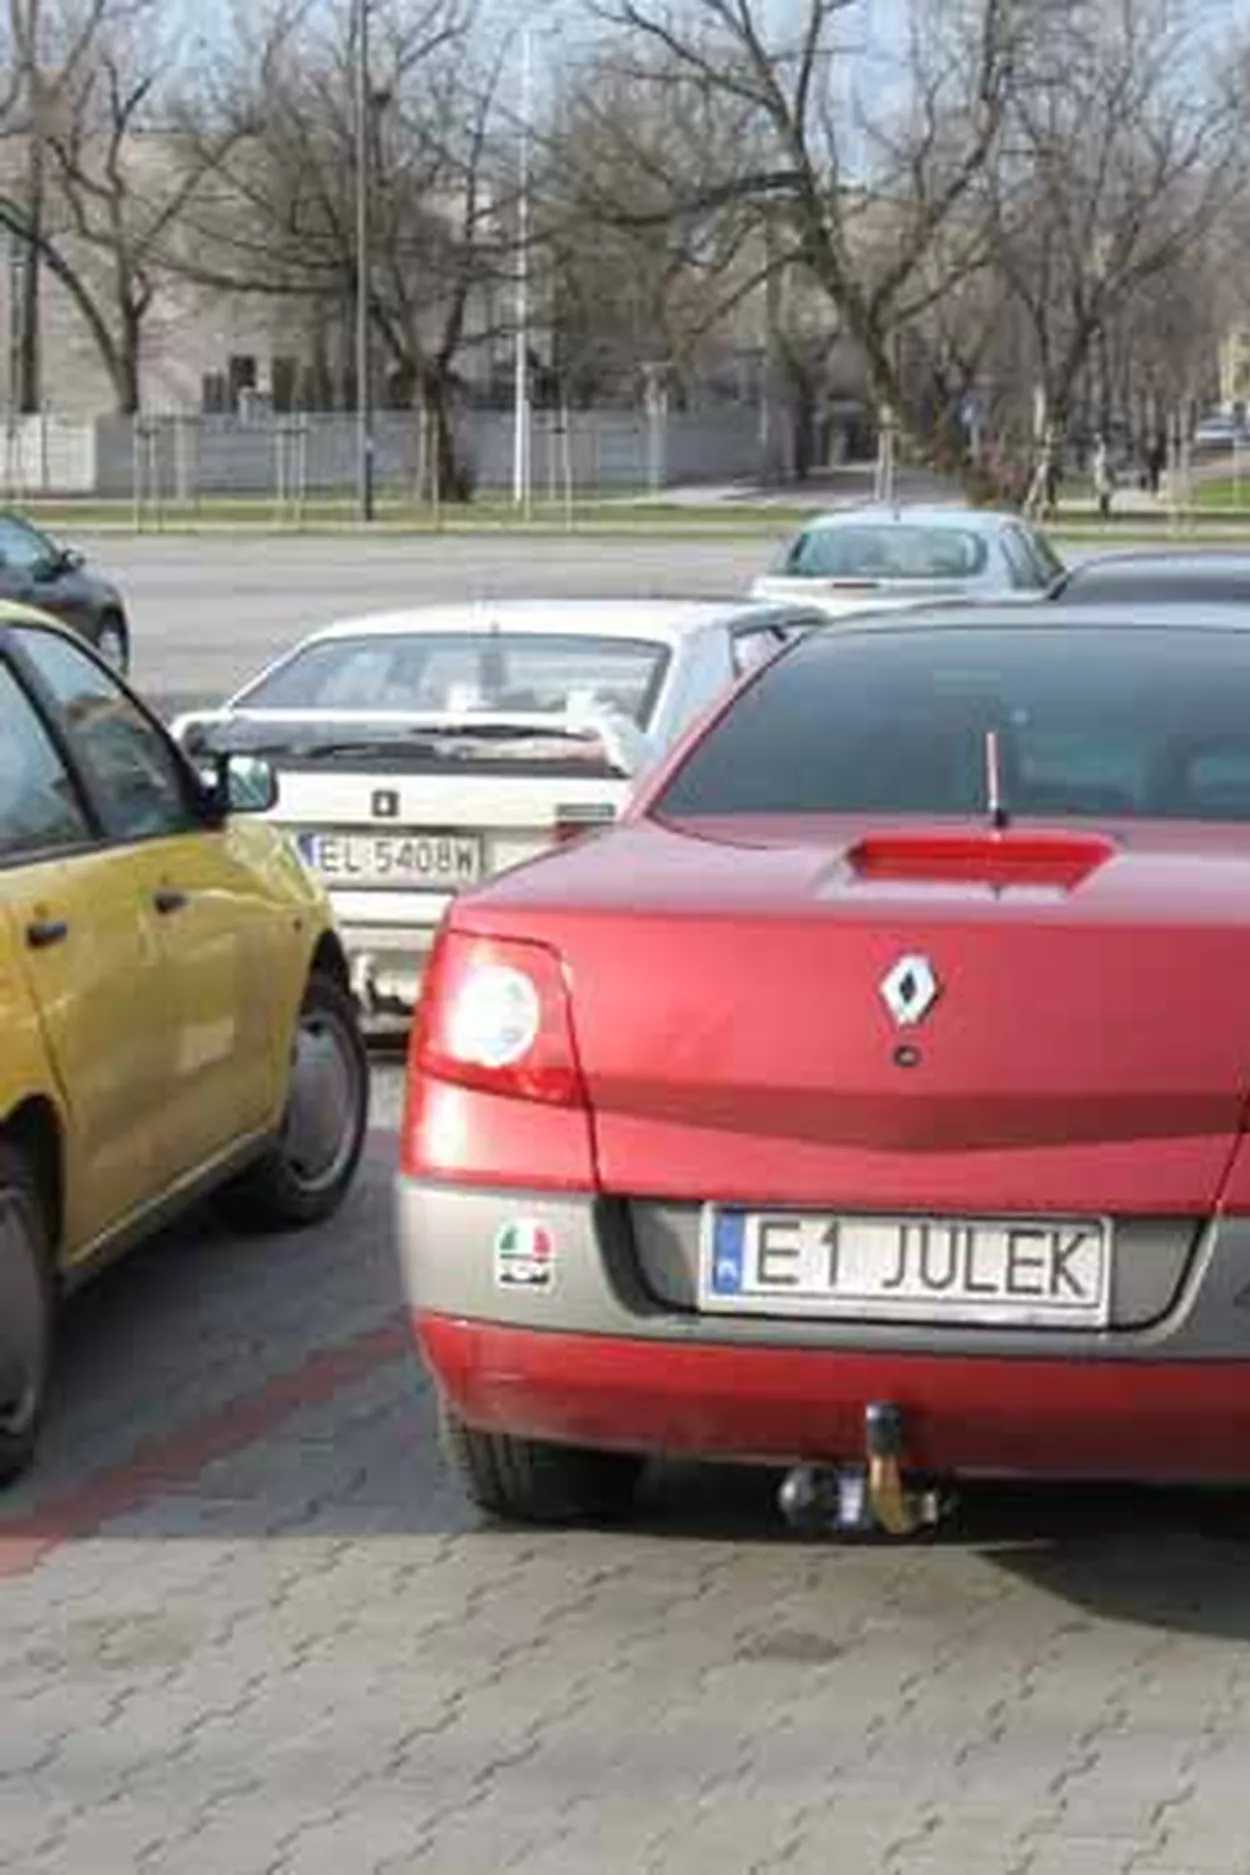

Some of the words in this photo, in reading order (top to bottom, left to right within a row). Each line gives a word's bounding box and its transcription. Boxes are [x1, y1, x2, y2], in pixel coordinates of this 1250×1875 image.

[319, 840, 361, 873] EL
[756, 1220, 840, 1287] E1
[881, 1222, 1088, 1297] JULEK
